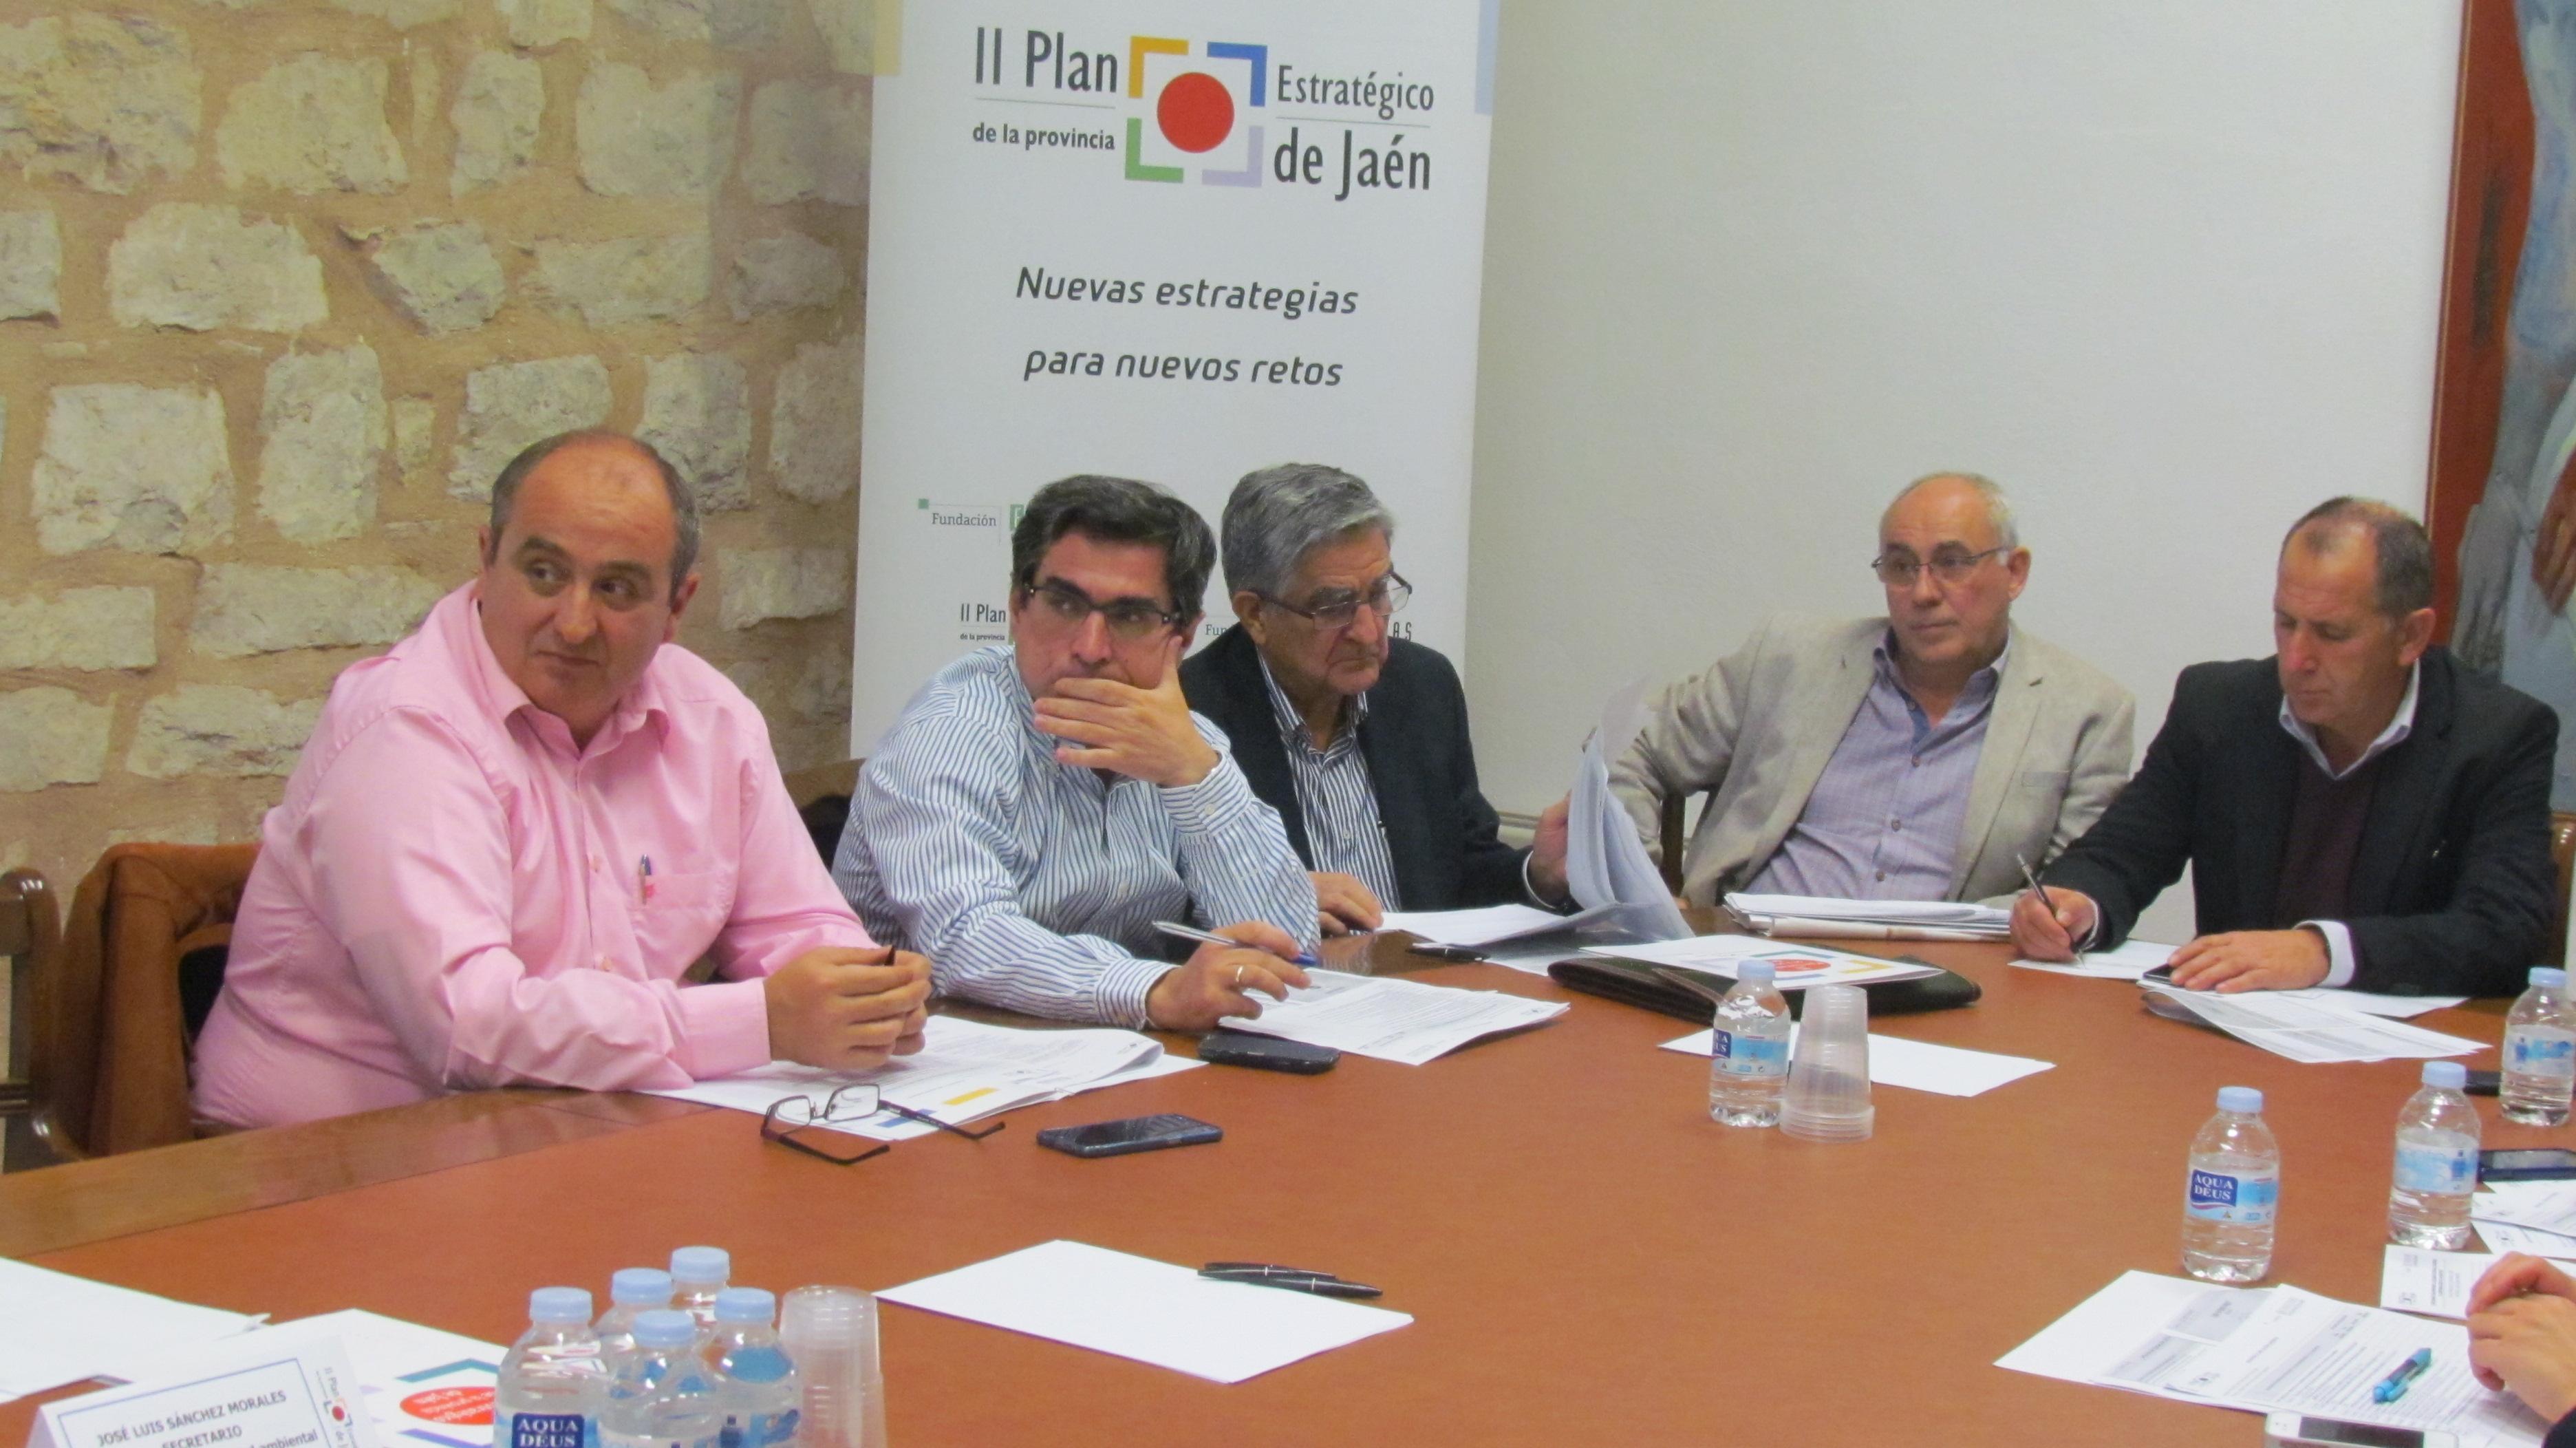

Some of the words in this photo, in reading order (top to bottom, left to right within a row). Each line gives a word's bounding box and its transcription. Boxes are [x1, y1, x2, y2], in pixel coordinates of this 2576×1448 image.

[1025, 30, 1118, 93] Plan
[1278, 64, 1435, 120] Estratégico
[972, 121, 997, 143] de
[1002, 123, 1020, 145] la
[1025, 127, 1115, 151] provincia
[1274, 126, 1323, 185] de
[1334, 129, 1430, 202] Jaén
[1016, 266, 1146, 304] Nuevas
[1155, 279, 1359, 321] estrategias
[1023, 350, 1104, 382] para
[1115, 354, 1241, 382] nuevos
[1251, 356, 1343, 387] retos
[932, 512, 997, 526] Fundación
[976, 604, 1007, 623] Plan
[2194, 1184, 2231, 1200] DEUS
[2195, 1174, 2234, 1189] AQUA
[97, 1425, 130, 1447] JOSÉ
[133, 1419, 164, 1438] LUIS
[166, 1405, 226, 1430] SÁNCHEZ
[227, 1390, 287, 1415] MORALES
[517, 1418, 579, 1436] AQUA
[519, 1434, 577, 1448] DEUS
